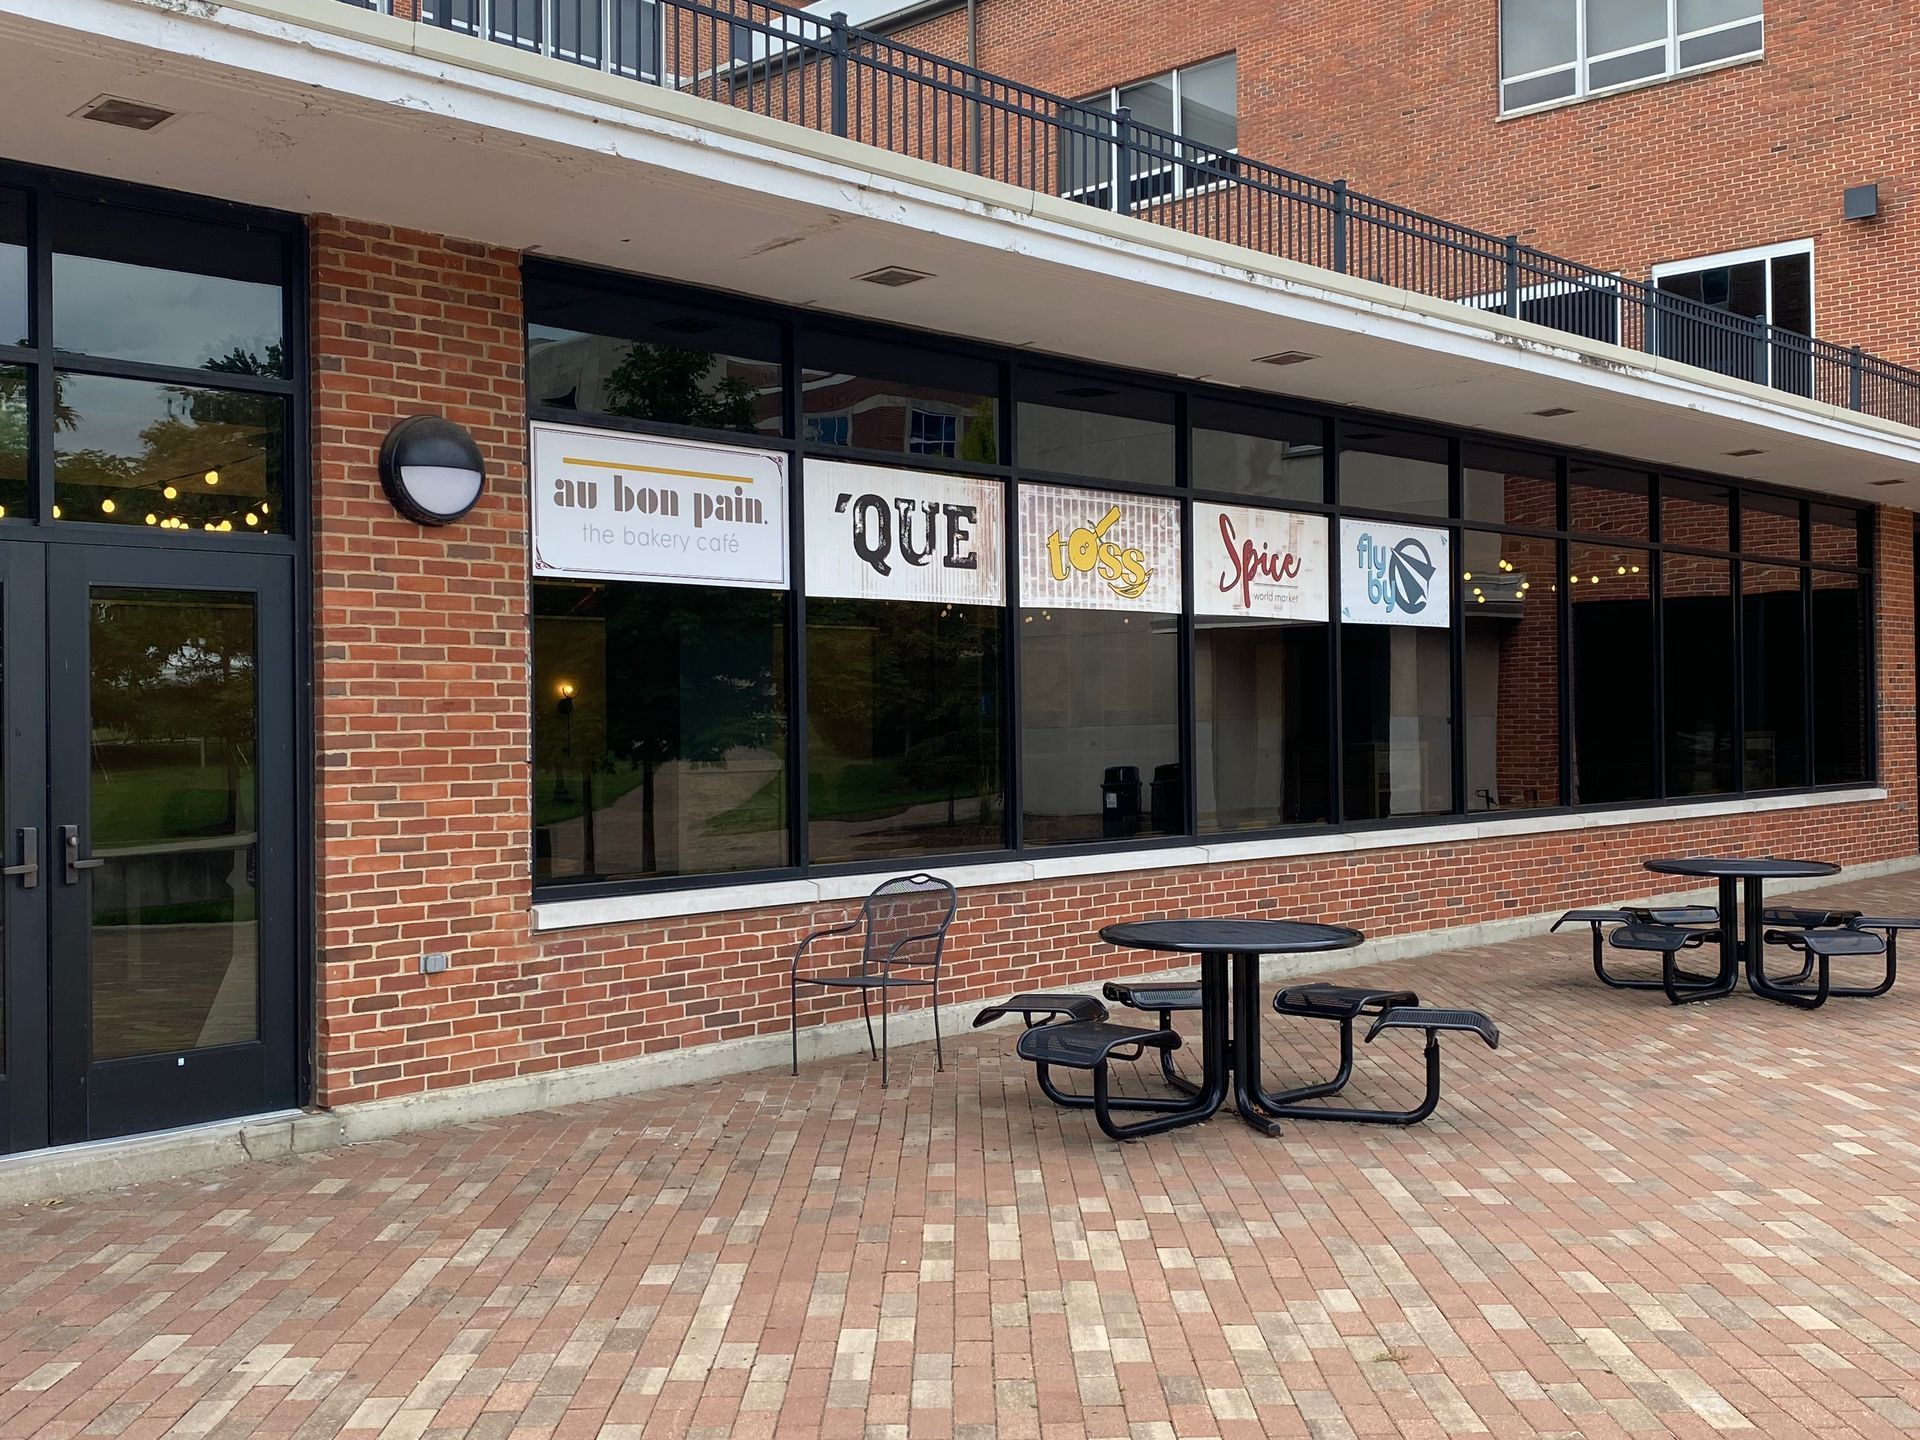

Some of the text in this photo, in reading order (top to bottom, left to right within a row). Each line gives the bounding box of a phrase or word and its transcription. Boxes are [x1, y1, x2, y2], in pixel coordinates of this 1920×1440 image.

[553, 479, 597, 509] au
[614, 475, 679, 517] bon
[583, 523, 739, 554] the bakery café
[1046, 507, 1151, 590] toss
[1358, 532, 1387, 578] fly
[1219, 513, 1301, 608] Spice
[1254, 590, 1299, 603] world market
[1367, 570, 1396, 612] by
